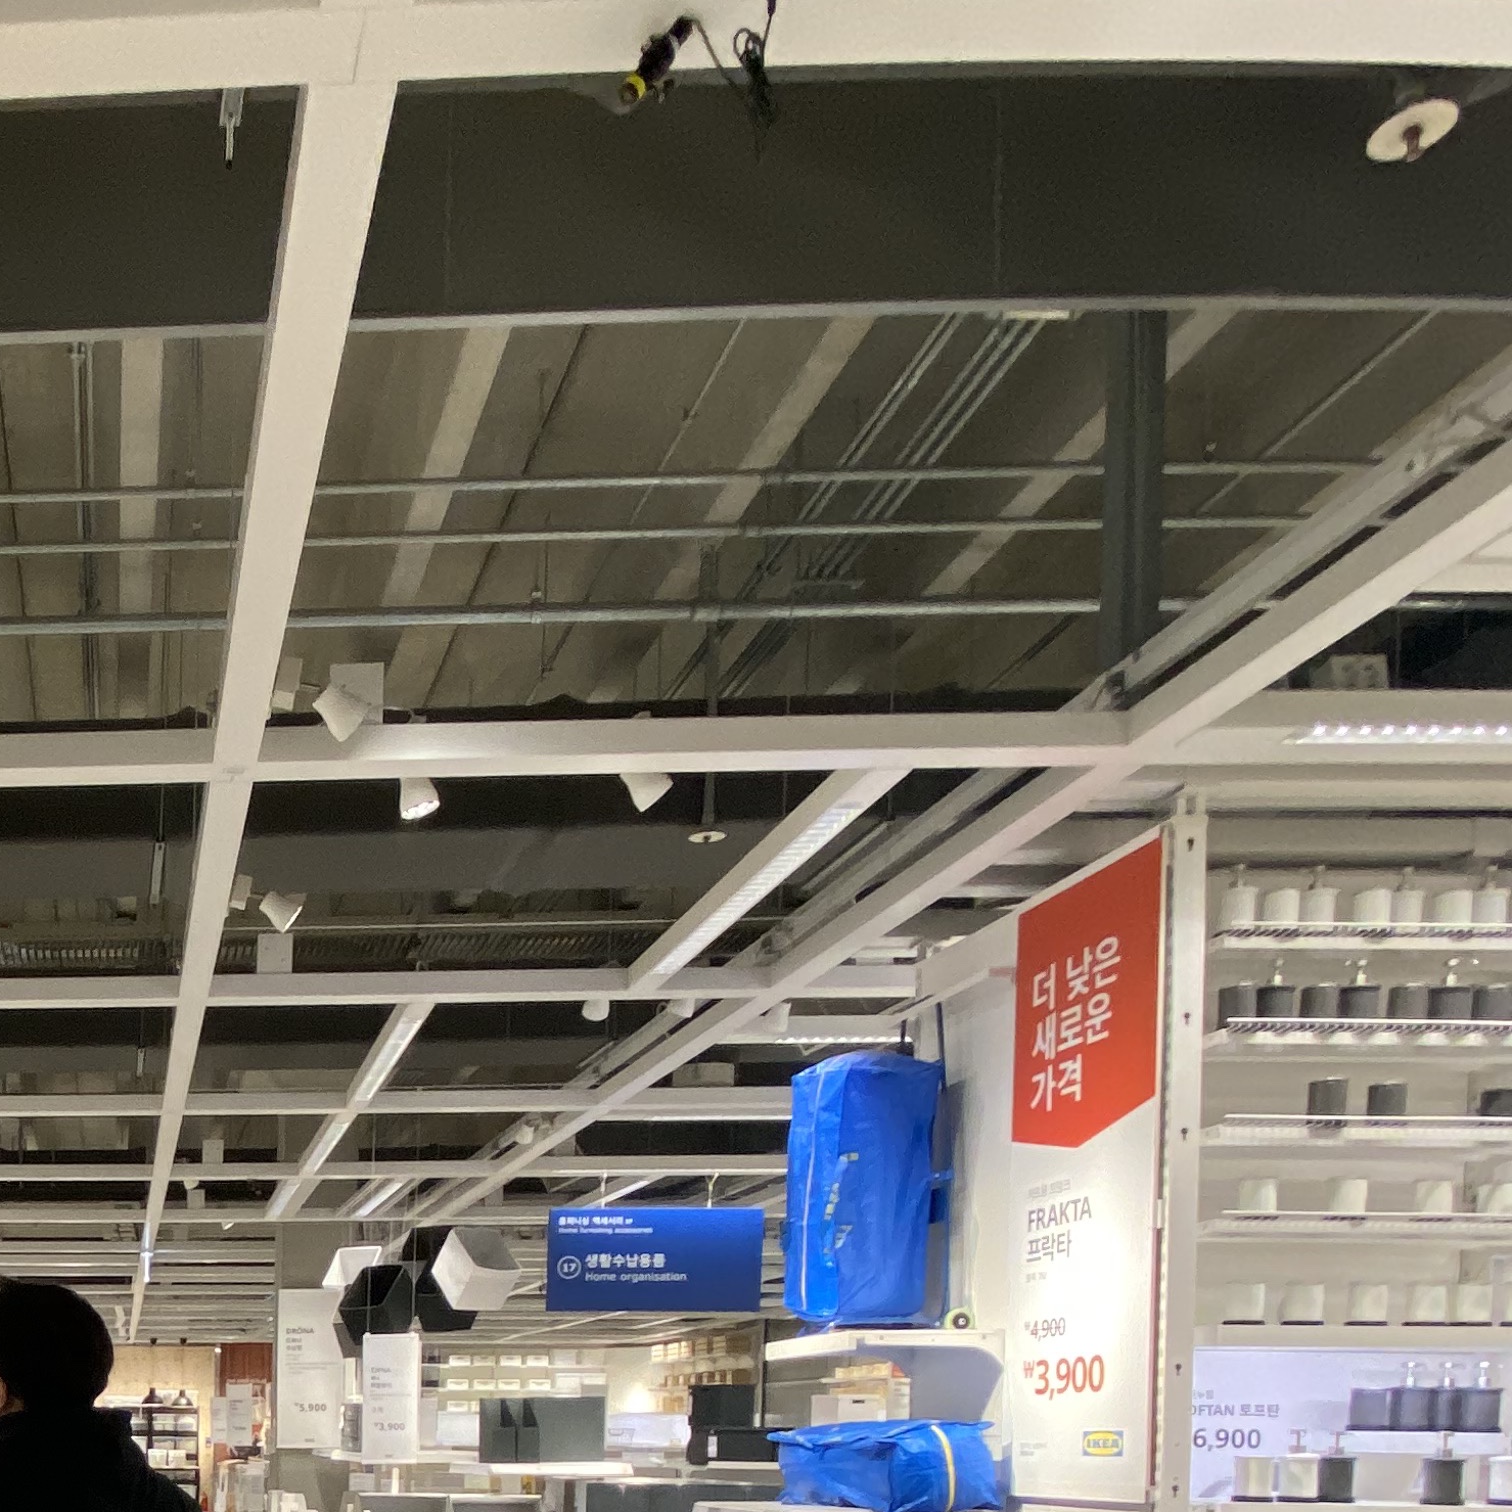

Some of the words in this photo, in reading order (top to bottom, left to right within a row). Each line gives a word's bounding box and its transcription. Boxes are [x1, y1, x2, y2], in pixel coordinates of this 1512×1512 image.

[1032, 961, 1056, 1011] 더
[1066, 936, 1121, 1001] 낮은
[1031, 992, 1113, 1060] 새로운
[1030, 1053, 1083, 1112] 가격
[1027, 1196, 1092, 1233] FRAKTA
[585, 1253, 666, 1269] 생활수납용품
[1026, 1230, 1072, 1262] 프락타
[562, 1262, 577, 1273] 17
[585, 1272, 617, 1282] Home
[620, 1272, 688, 1283] organisation
[1023, 1354, 1105, 1401] ₩3,900
[1239, 1403, 1280, 1418] 토프탄
[1193, 1428, 1261, 1452] 6,900
